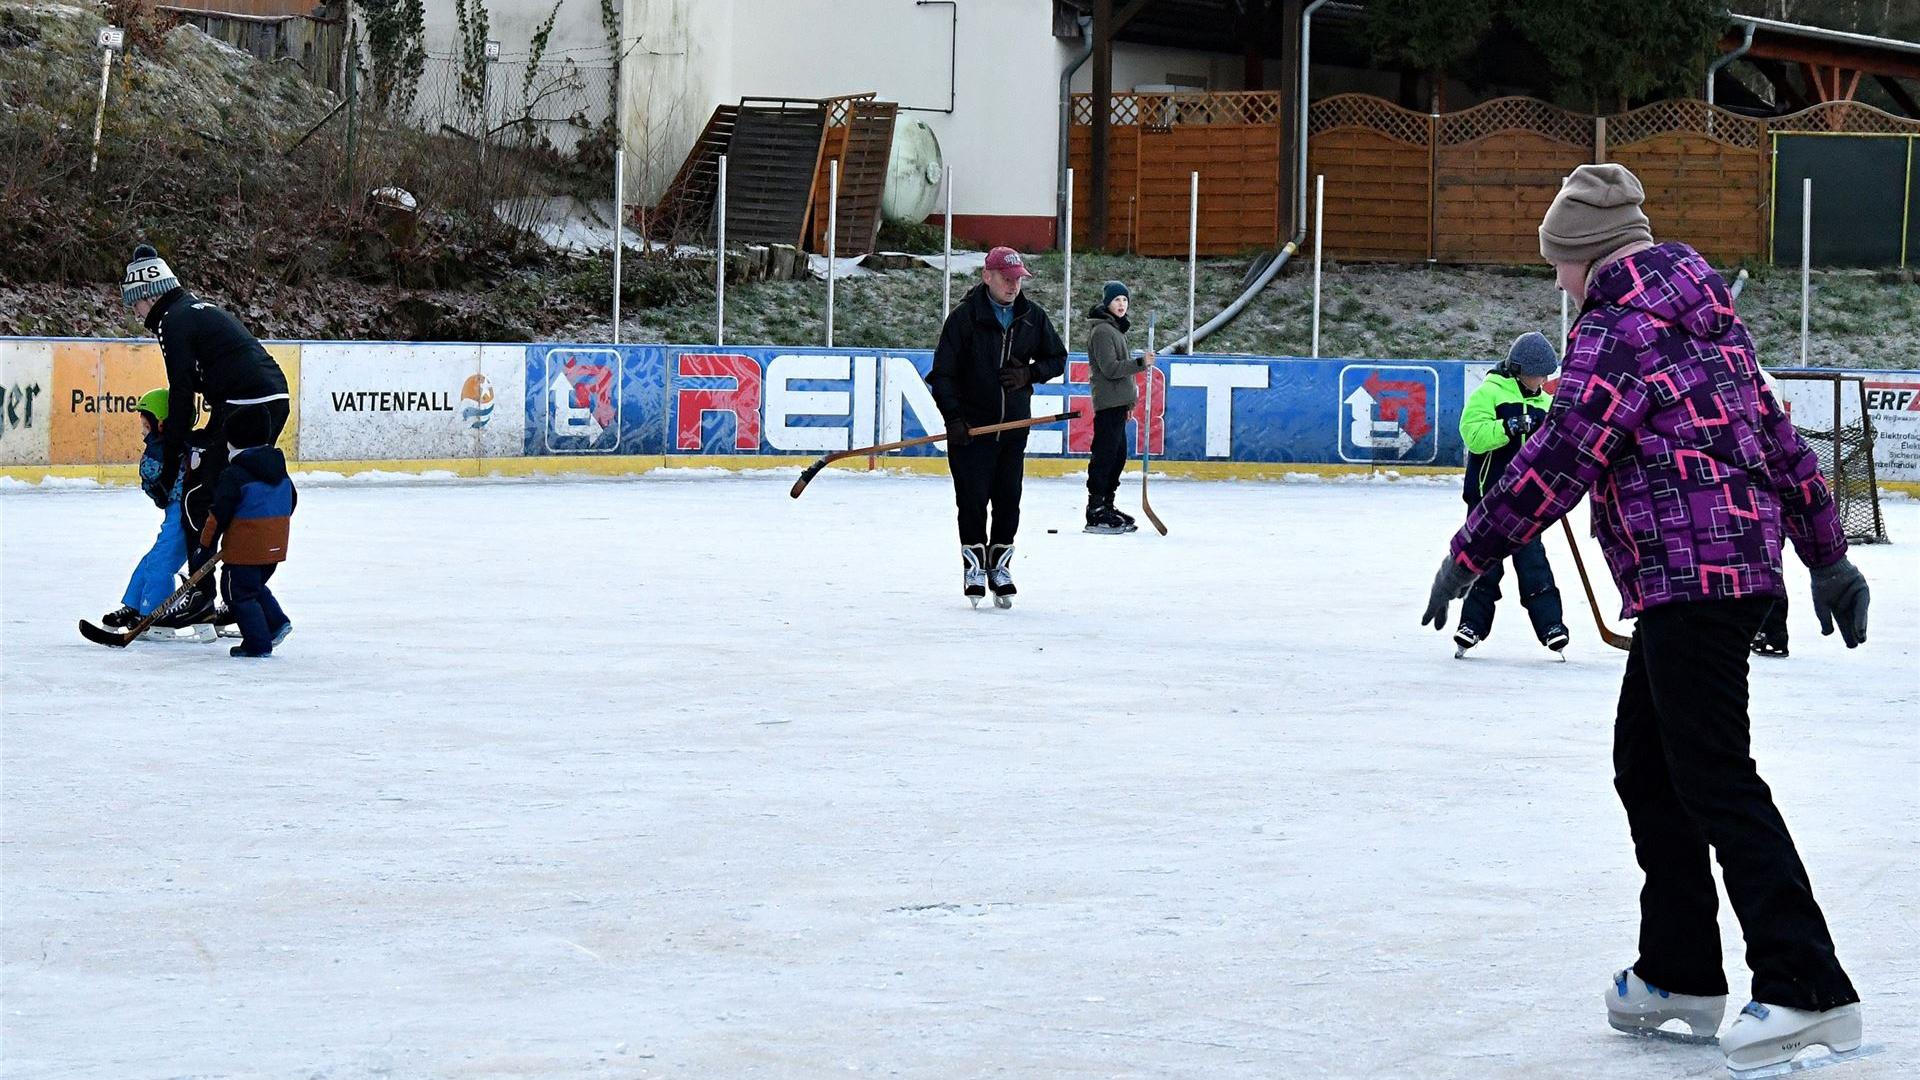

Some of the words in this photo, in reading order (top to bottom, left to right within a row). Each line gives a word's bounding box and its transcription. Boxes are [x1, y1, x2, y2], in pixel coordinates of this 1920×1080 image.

[0, 382, 41, 438] er
[71, 389, 142, 413] Partne
[331, 391, 454, 412] VATTENFALL
